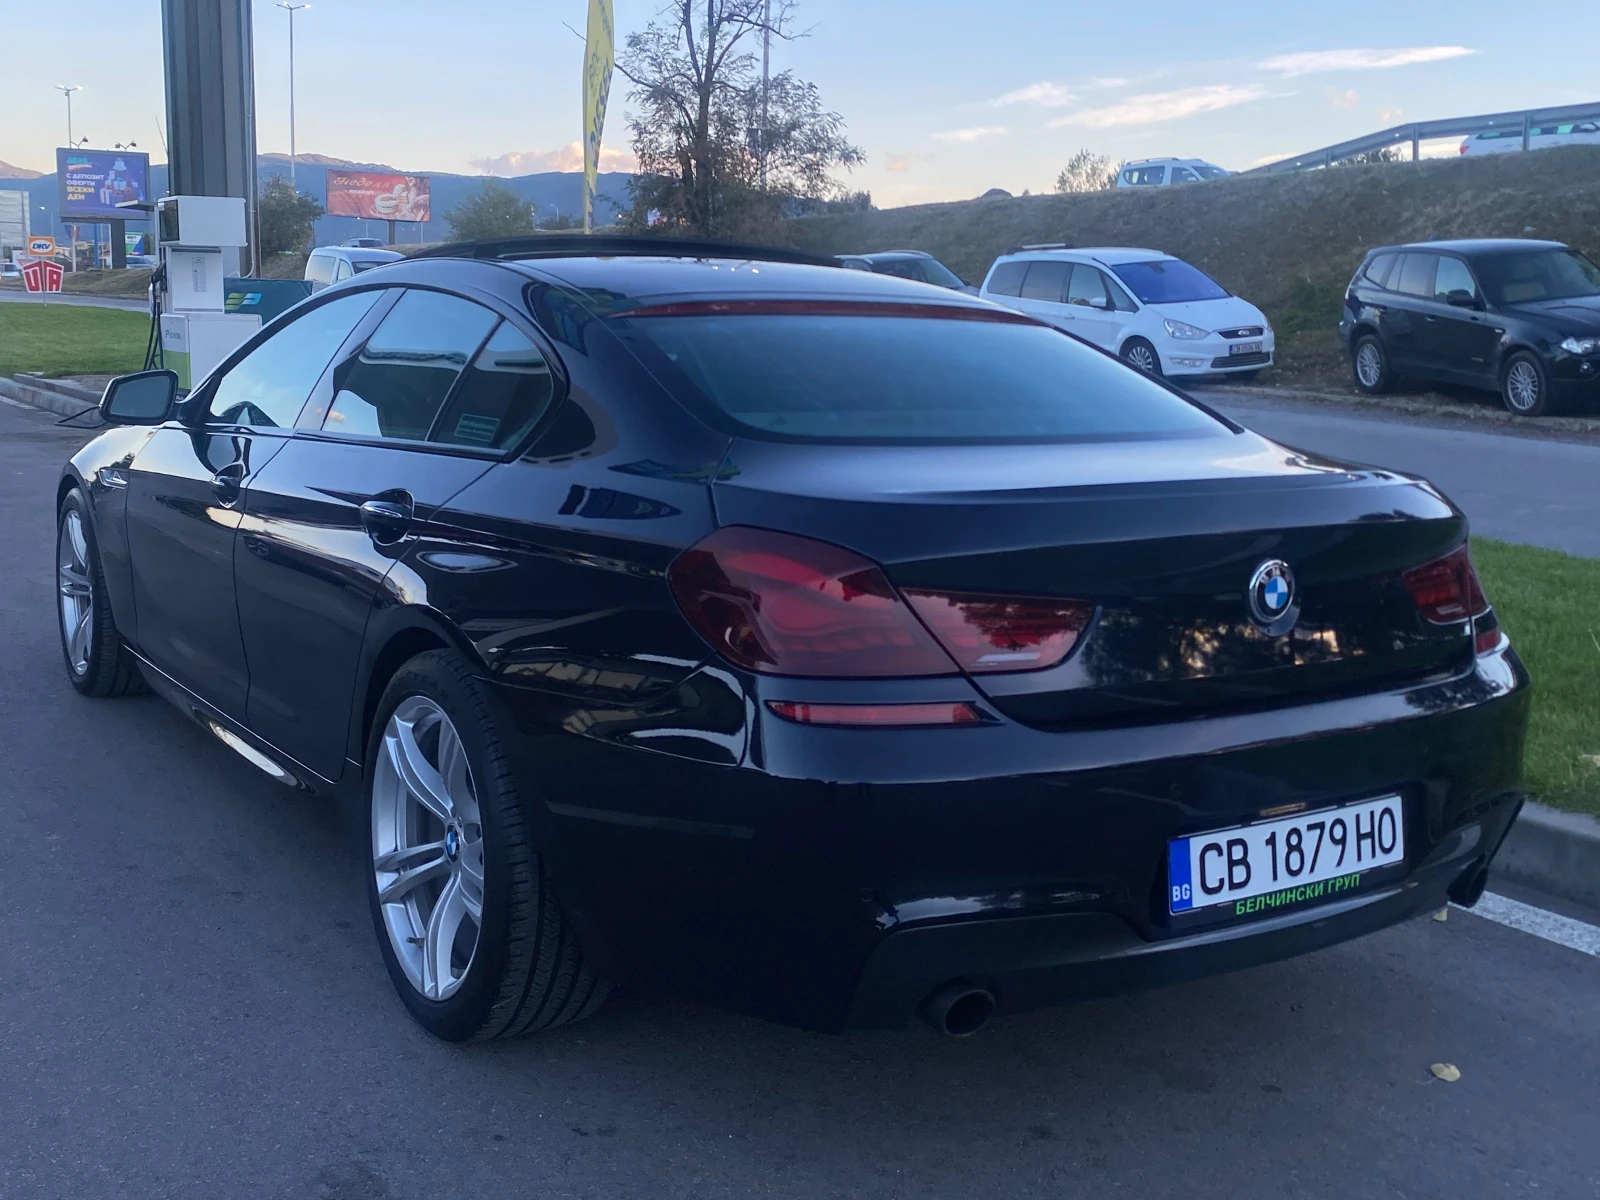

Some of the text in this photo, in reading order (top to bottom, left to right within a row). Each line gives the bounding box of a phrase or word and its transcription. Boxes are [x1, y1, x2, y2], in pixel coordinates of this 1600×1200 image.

[1199, 806, 1397, 895] CB 1879 HO
[1172, 883, 1191, 902] BG
[1235, 873, 1361, 915] БЕЛЧИНСКИ ГРУП
